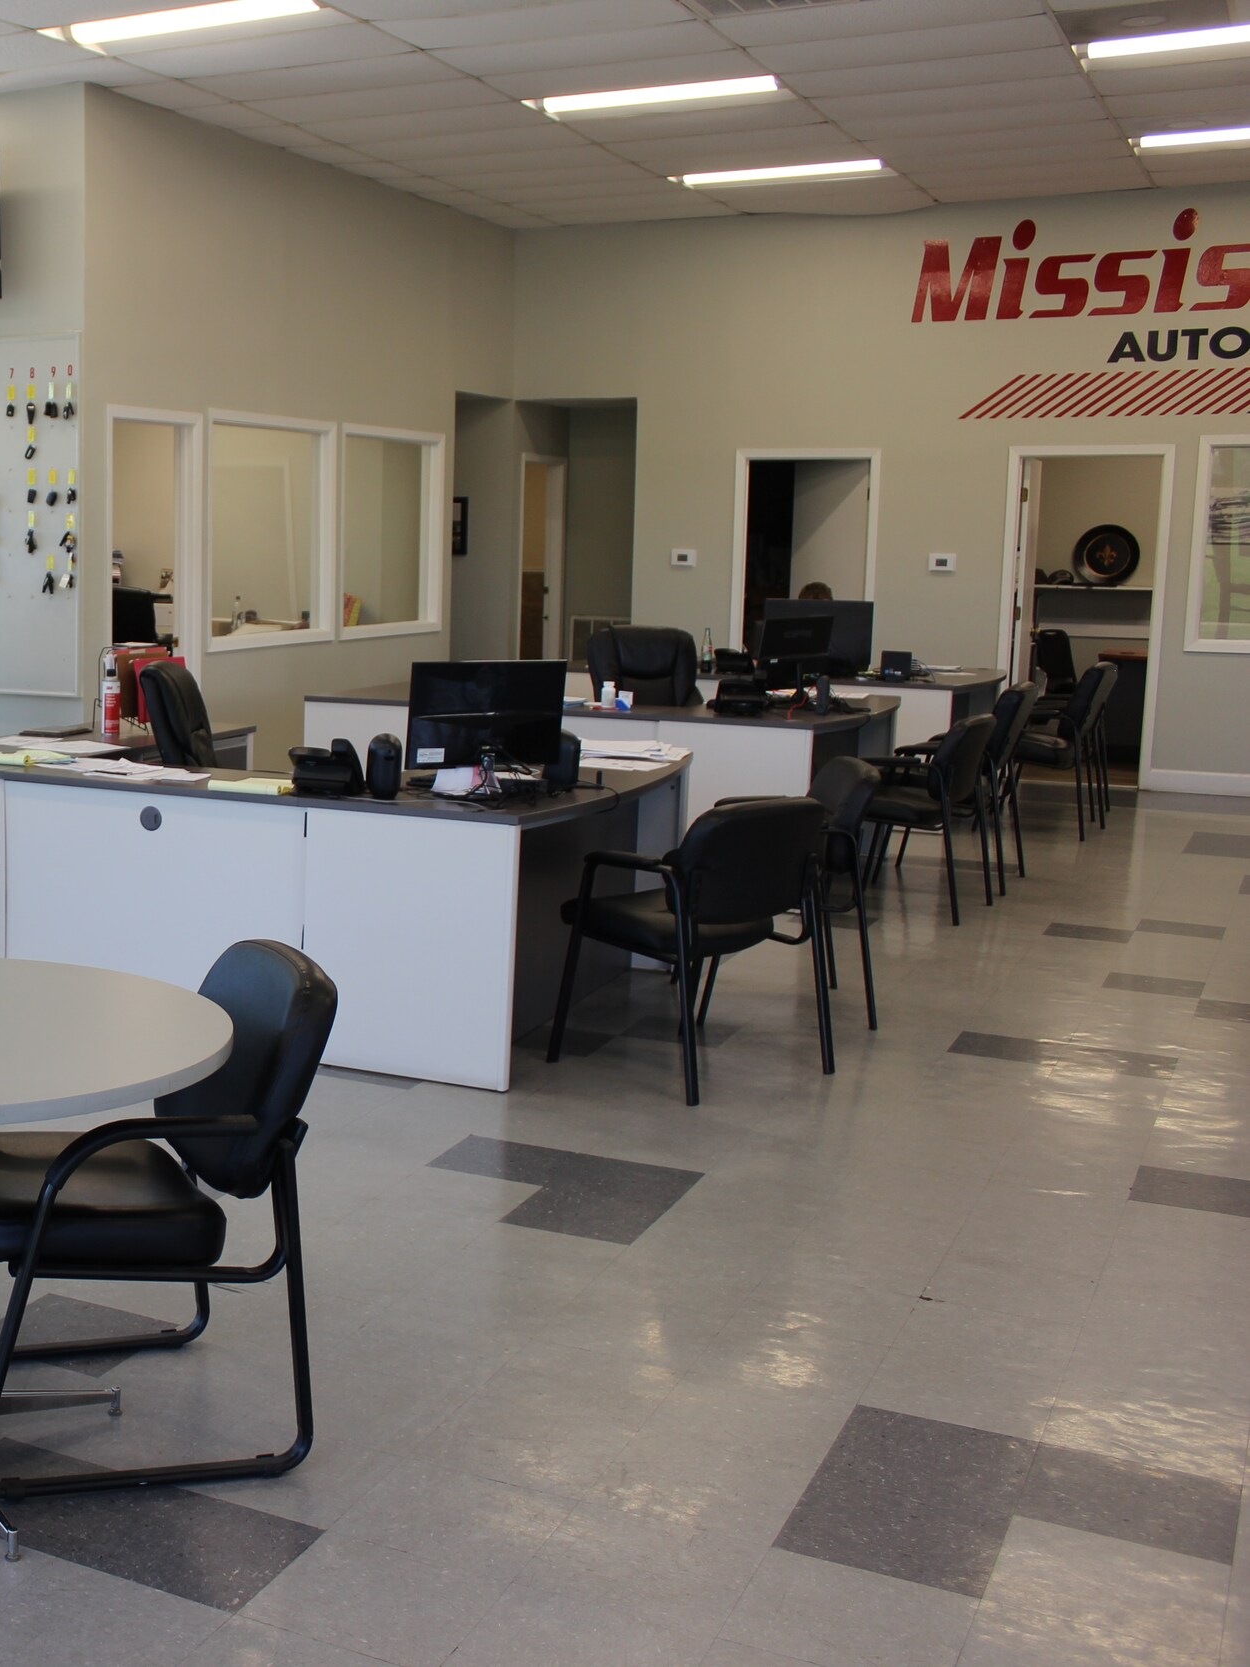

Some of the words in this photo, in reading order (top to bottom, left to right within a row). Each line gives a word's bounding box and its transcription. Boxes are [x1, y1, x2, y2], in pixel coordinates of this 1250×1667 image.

[1107, 326, 1250, 363] AUTO
[9, 368, 15, 379] 7
[30, 367, 35, 379] 8
[51, 366, 56, 377] 9
[67, 364, 73, 376] 0
